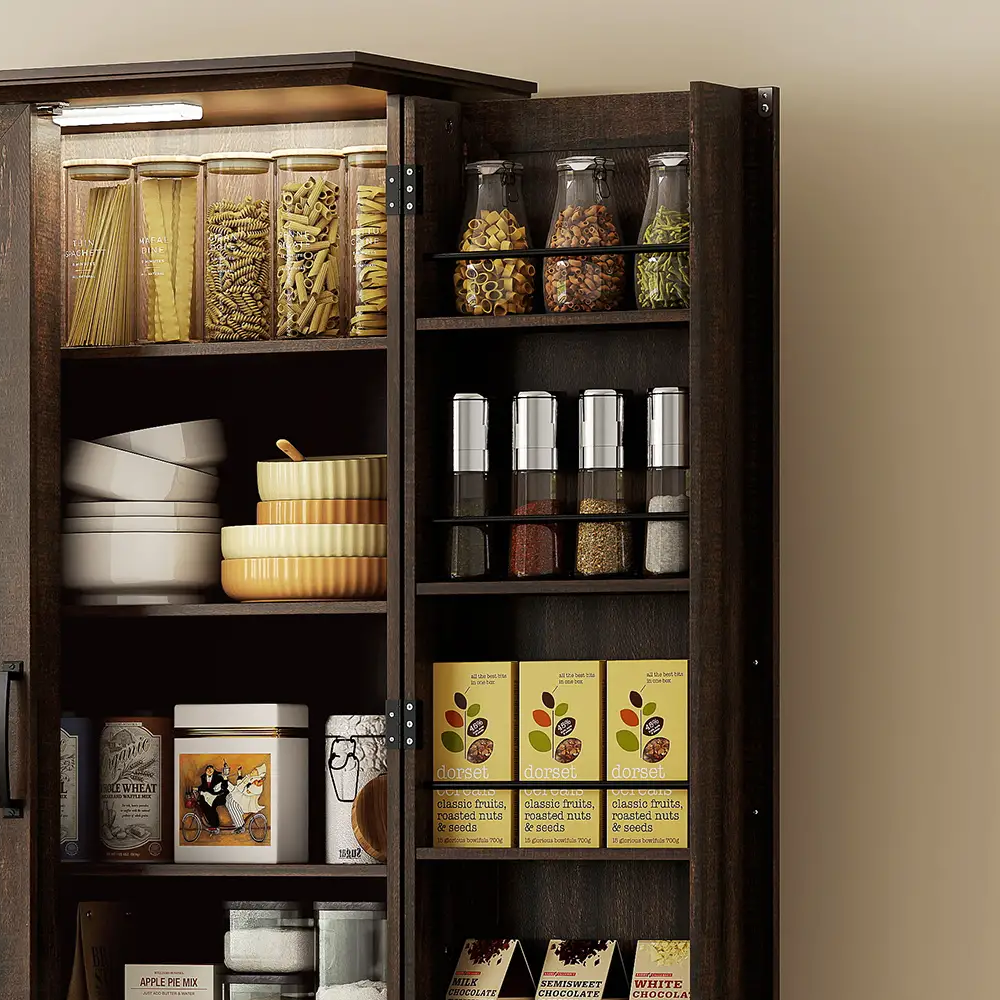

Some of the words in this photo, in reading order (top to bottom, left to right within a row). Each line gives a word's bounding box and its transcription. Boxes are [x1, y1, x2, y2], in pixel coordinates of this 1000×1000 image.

[103, 736, 150, 780] rganic
[437, 765, 489, 779] dorset
[524, 764, 577, 779] dorset
[611, 764, 665, 779] dorset
[100, 784, 120, 794] HOLE
[122, 784, 157, 794] WHEAT
[437, 799, 472, 809] classic
[475, 799, 507, 810] fruits,
[524, 799, 560, 809] classic
[562, 799, 595, 810] fruits,
[611, 799, 648, 809] classic
[650, 799, 683, 810] fruits,
[437, 811, 476, 820] roasted
[479, 811, 503, 820] nuts
[524, 811, 564, 820] roasted
[567, 811, 592, 820] nuts
[611, 811, 652, 820] roasted
[655, 811, 680, 820] nuts
[437, 822, 446, 832] &
[448, 823, 477, 832] seeds
[524, 822, 534, 832] &
[536, 823, 565, 832] seeds
[611, 822, 621, 832] &
[624, 823, 653, 832] seeds
[140, 977, 166, 987] APPLE
[167, 977, 181, 987] PIE
[182, 978, 198, 987] MIX
[451, 978, 479, 986] MILK
[540, 980, 602, 988] SEMISWEET
[634, 979, 683, 989] WHITE
[448, 988, 497, 996] CHOCOLATE
[538, 989, 600, 998] CHOCOLATE
